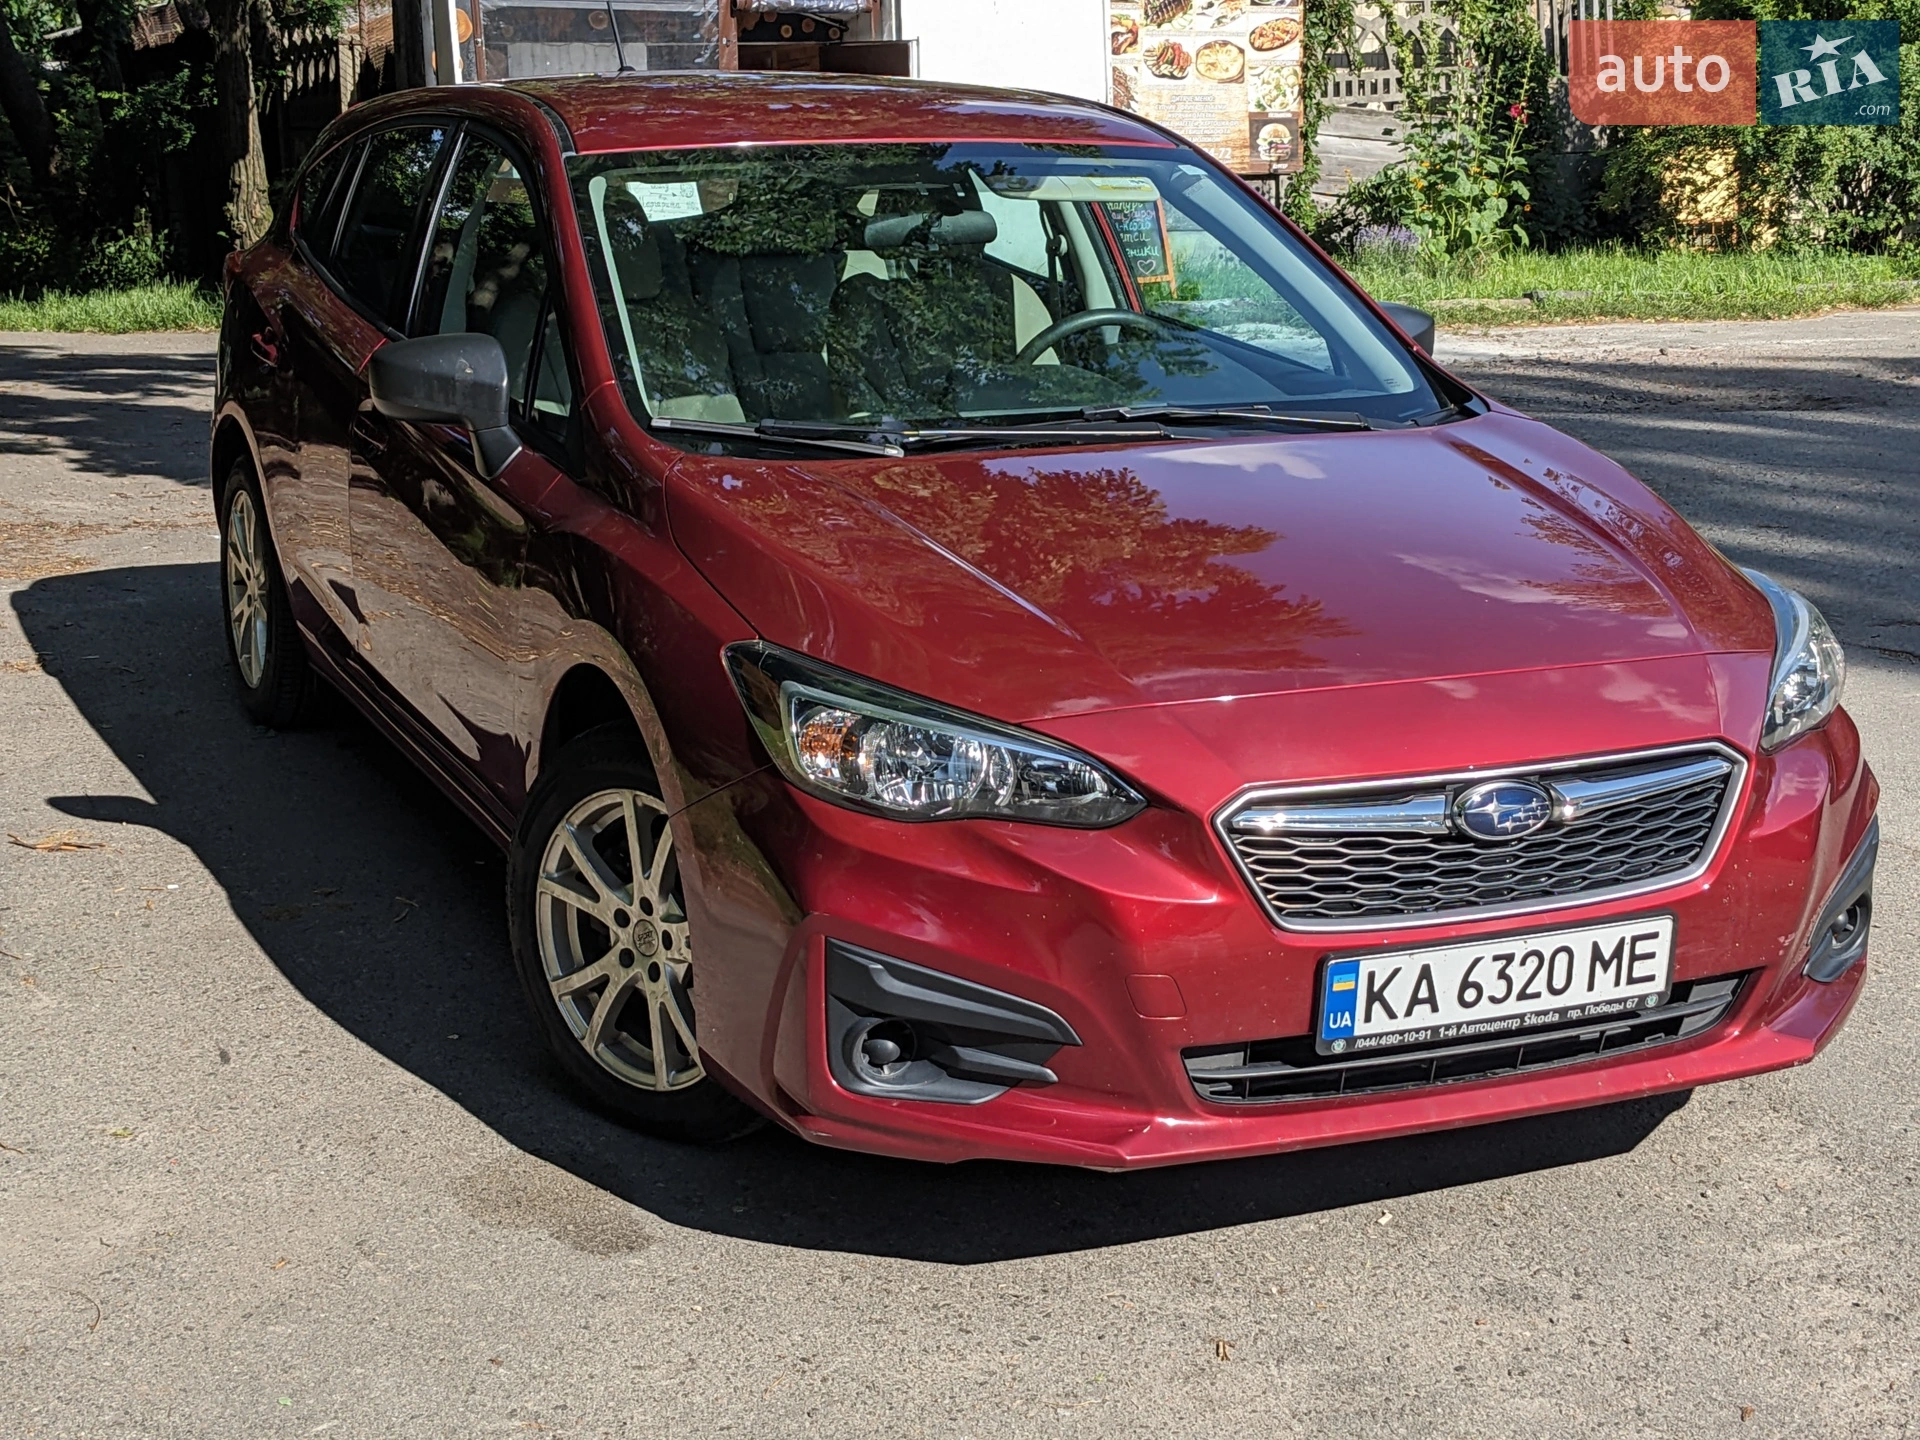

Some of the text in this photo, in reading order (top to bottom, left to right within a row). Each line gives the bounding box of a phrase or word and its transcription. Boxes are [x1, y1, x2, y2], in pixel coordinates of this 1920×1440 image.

[1364, 931, 1660, 1023] KA 6320 ME
[1329, 1011, 1352, 1029] UA
[1438, 1025, 1458, 1038] 1-й
[1458, 1017, 1521, 1036] Автоцентр
[1523, 1013, 1560, 1027] Škoda
[1567, 1008, 1583, 1021] пр.
[1584, 1003, 1625, 1018] Победы
[1626, 998, 1639, 1009] 67
